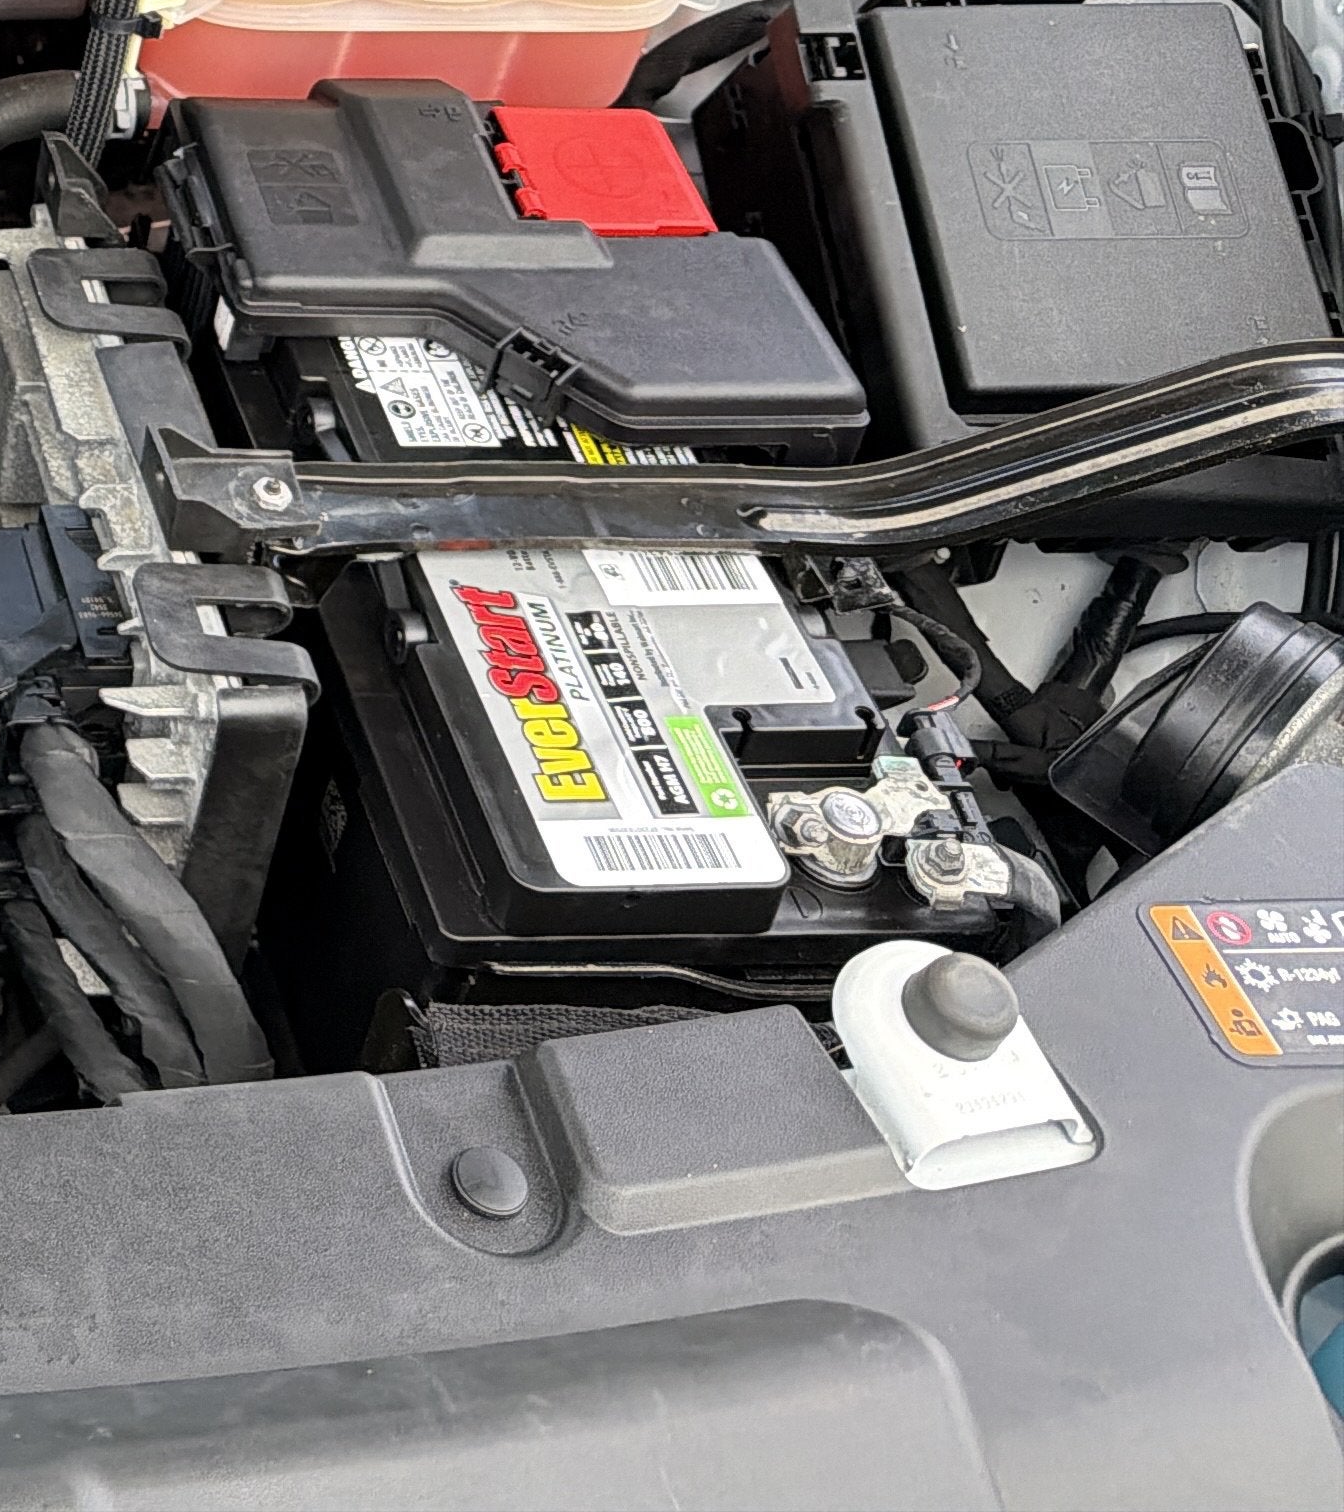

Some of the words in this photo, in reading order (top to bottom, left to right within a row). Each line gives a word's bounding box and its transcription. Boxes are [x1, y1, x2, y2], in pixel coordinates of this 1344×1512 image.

[525, 600, 591, 702] PLATINUM
[605, 611, 647, 681] NONSPILLABLE
[609, 662, 631, 686] 140
[653, 754, 674, 772] H7
[663, 773, 691, 804] AGM
[1268, 931, 1301, 944] AUTO
[1306, 1011, 1341, 1027] PAG
